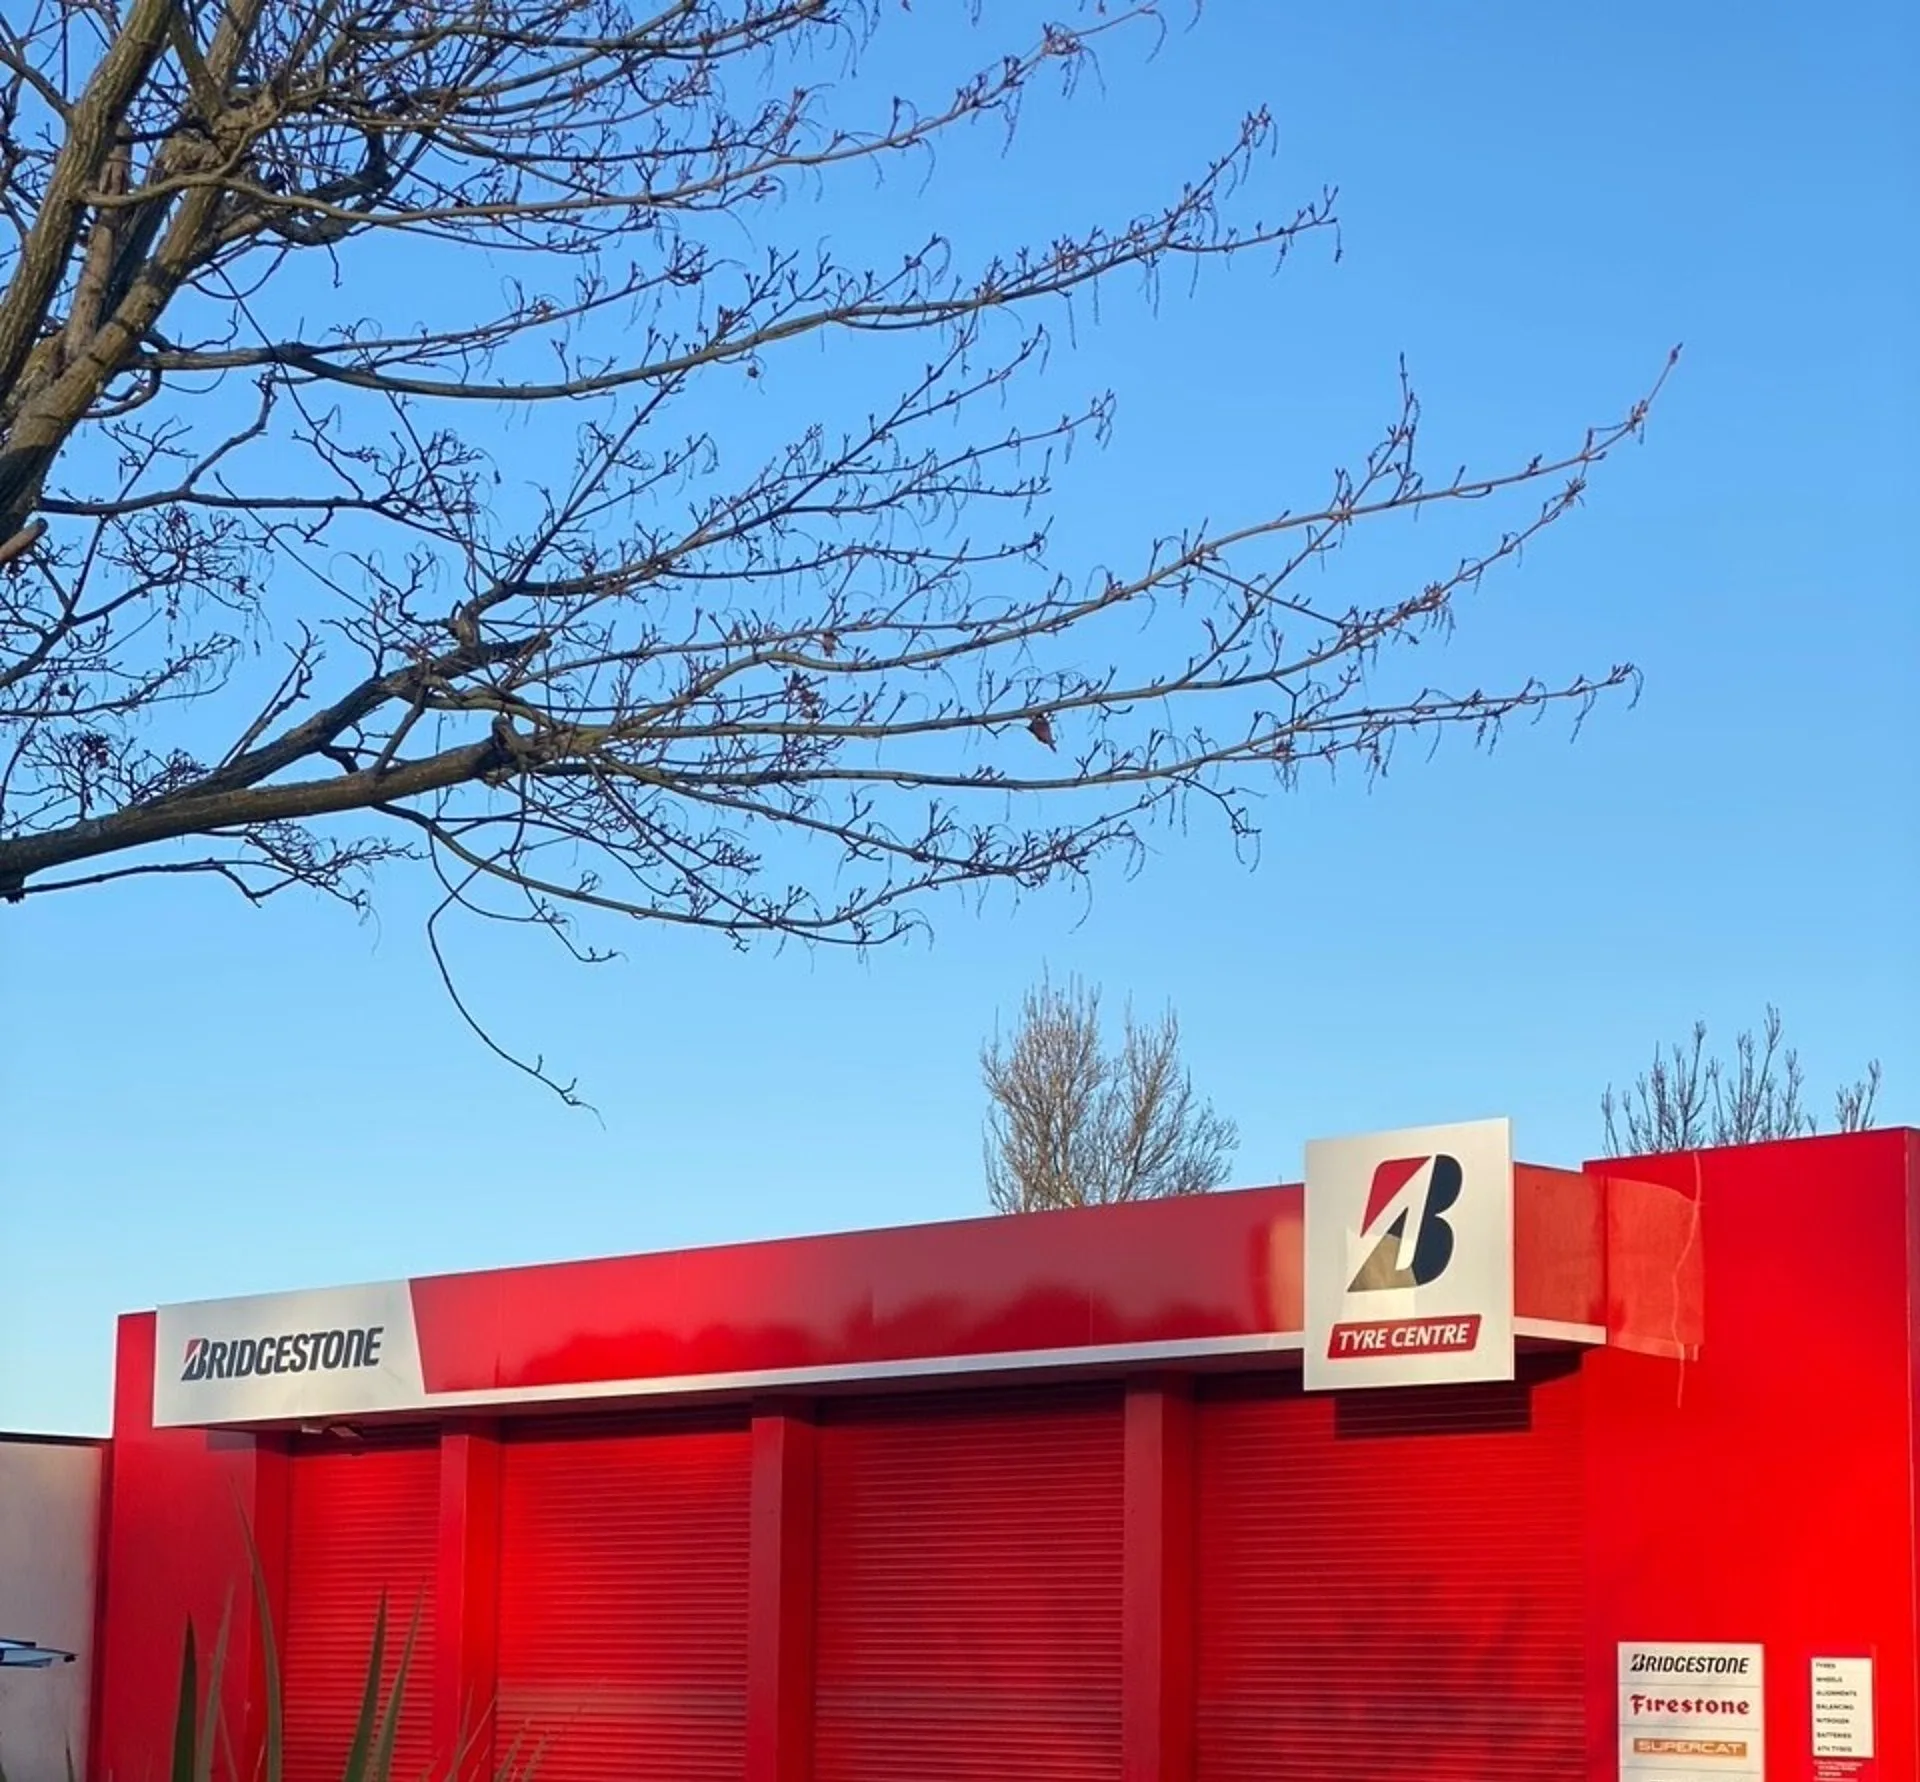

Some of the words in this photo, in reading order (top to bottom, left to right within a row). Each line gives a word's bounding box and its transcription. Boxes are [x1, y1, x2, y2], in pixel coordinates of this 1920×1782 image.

[1338, 1328, 1387, 1350] TYRE
[1391, 1323, 1470, 1347] CENTRE
[181, 1326, 384, 1381] BRIDGESTONE
[1630, 1654, 1750, 1674] BRIDGESTONE
[1630, 1694, 1750, 1716] Firestone
[1637, 1740, 1742, 1754] SUPERCAT
